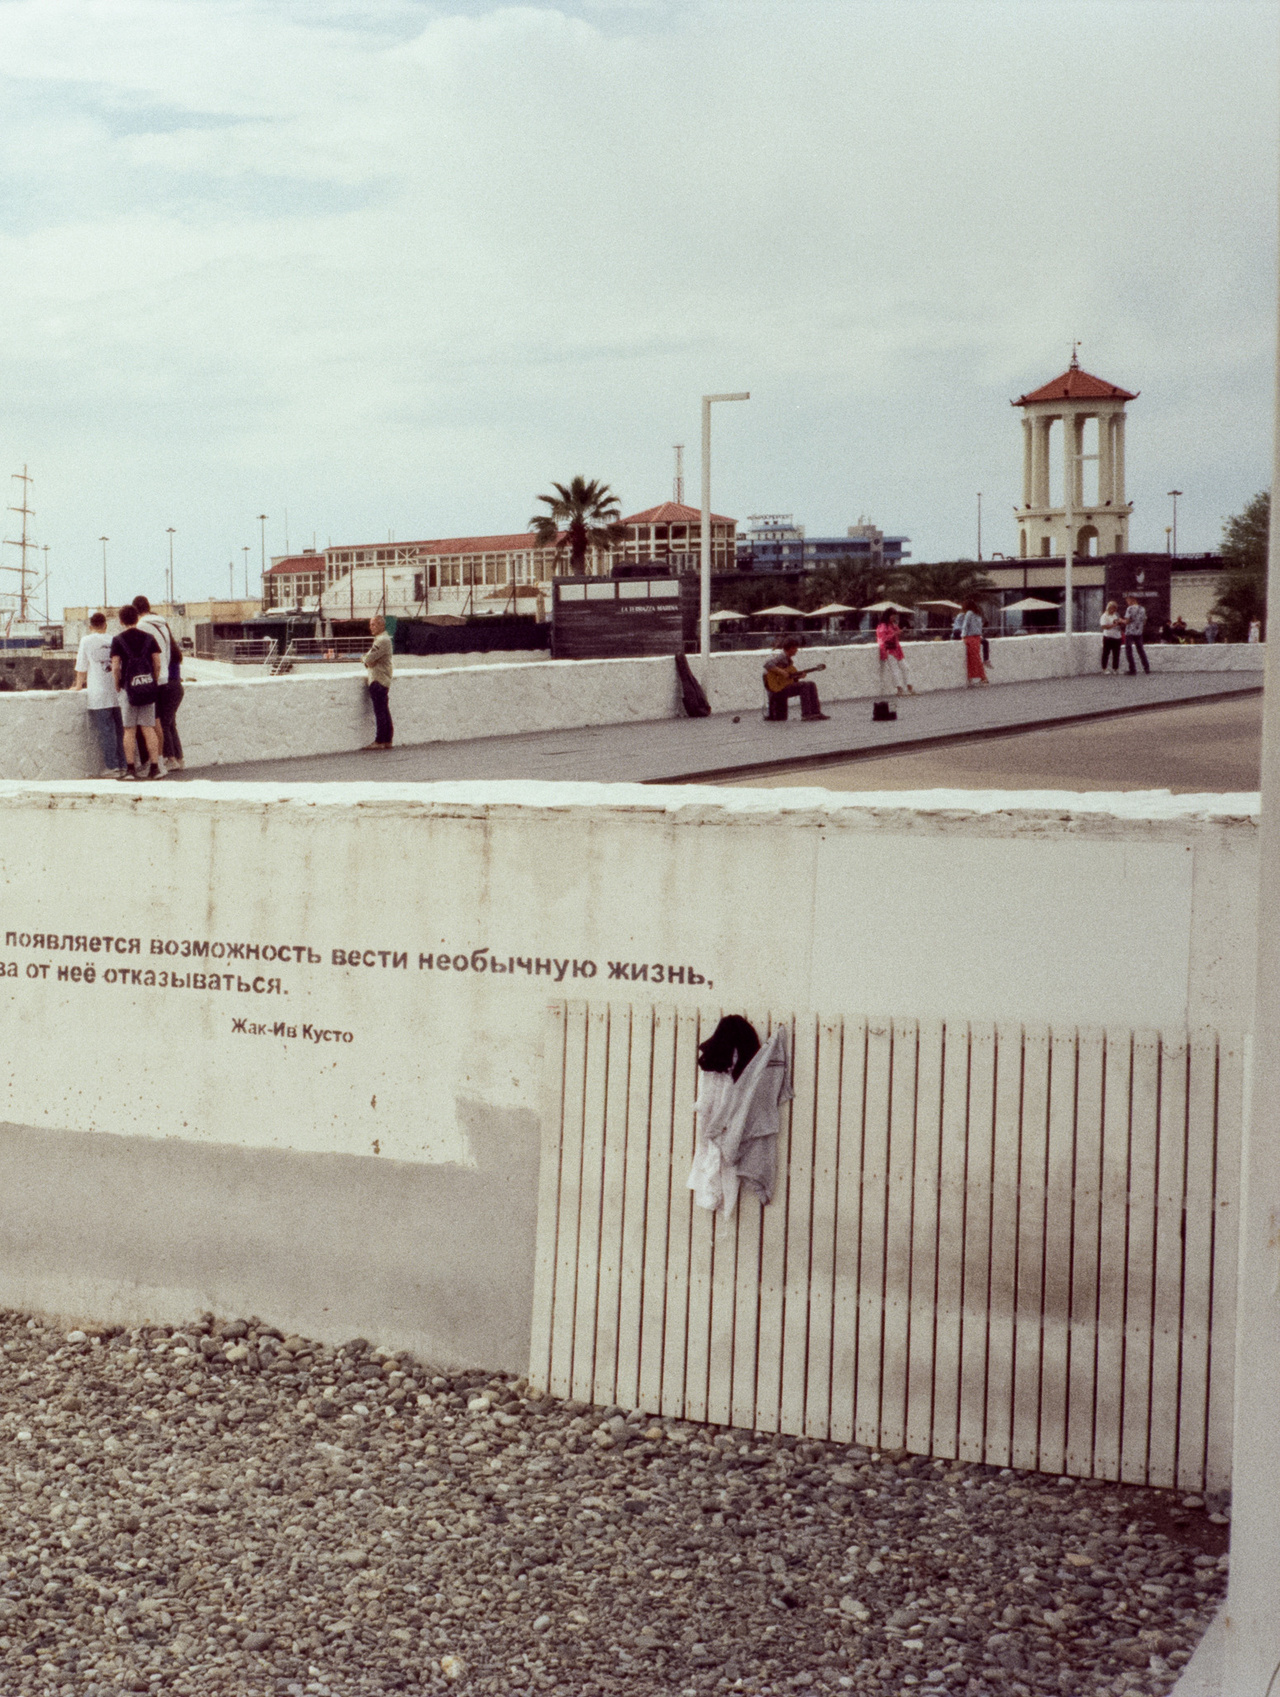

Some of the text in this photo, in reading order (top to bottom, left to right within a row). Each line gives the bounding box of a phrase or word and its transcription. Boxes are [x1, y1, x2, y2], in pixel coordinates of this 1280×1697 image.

[131, 673, 154, 687] VANS
[5, 930, 141, 955] появляется
[149, 938, 322, 964] возможность
[331, 948, 409, 970] вести
[418, 946, 598, 983] необычную
[606, 960, 714, 990] жизнь,
[25, 962, 51, 980] от
[56, 962, 97, 985] неё
[102, 967, 289, 996] отказываться.
[231, 1017, 355, 1045] Жак-Ив Кусто
